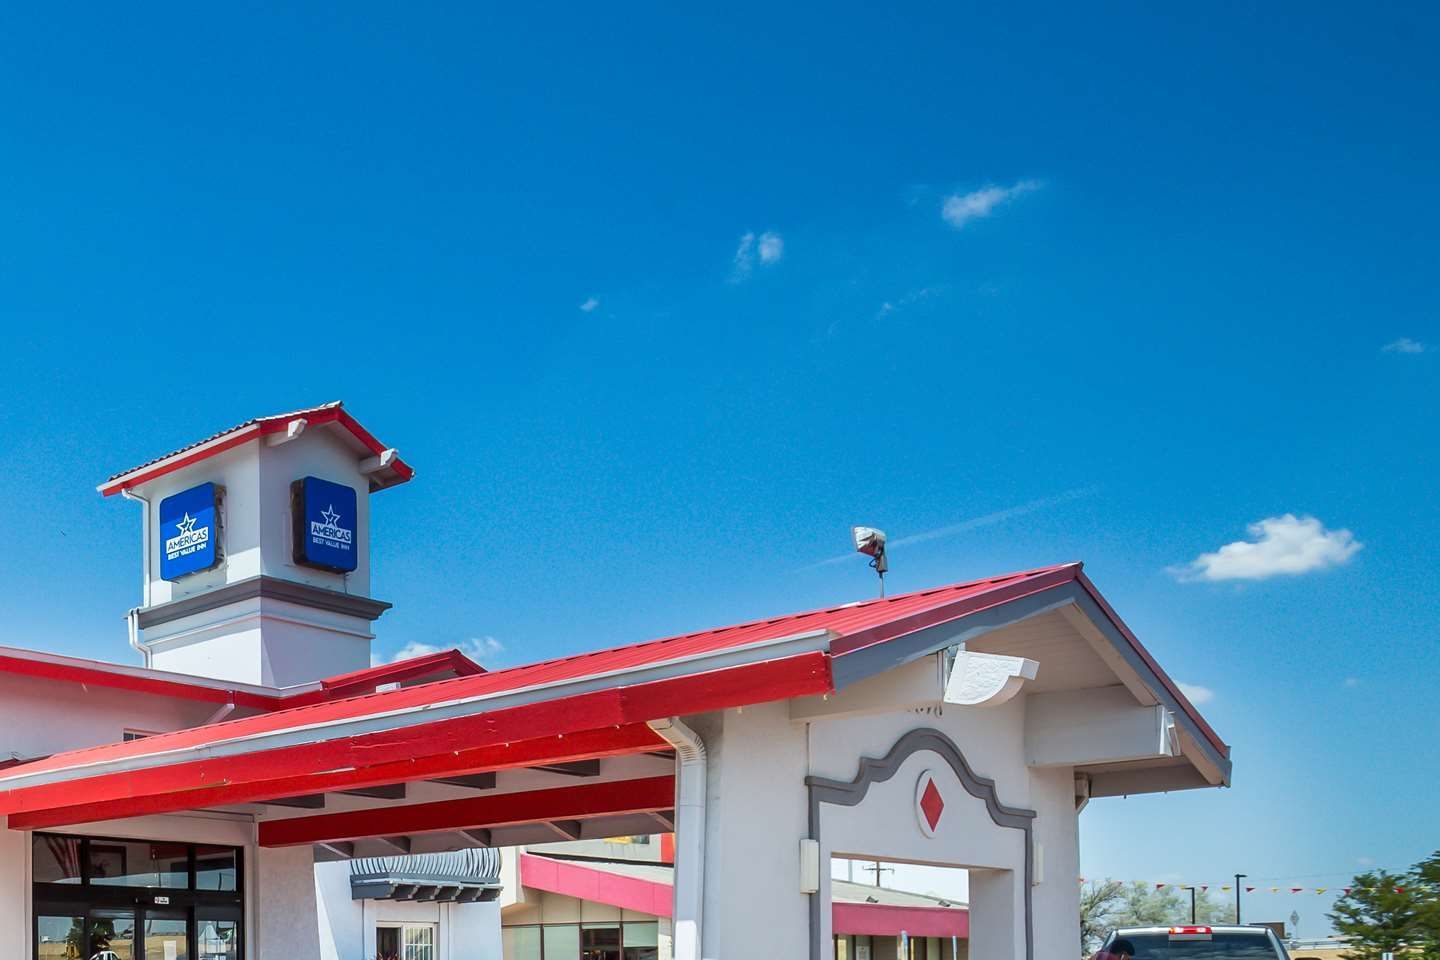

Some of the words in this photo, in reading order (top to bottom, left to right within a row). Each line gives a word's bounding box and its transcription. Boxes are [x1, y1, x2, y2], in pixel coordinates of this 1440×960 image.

[168, 530, 207, 551] AMERICAS
[312, 524, 350, 542] AMERICAS
[313, 536, 324, 544] BEST
[325, 540, 339, 549] VALUE
